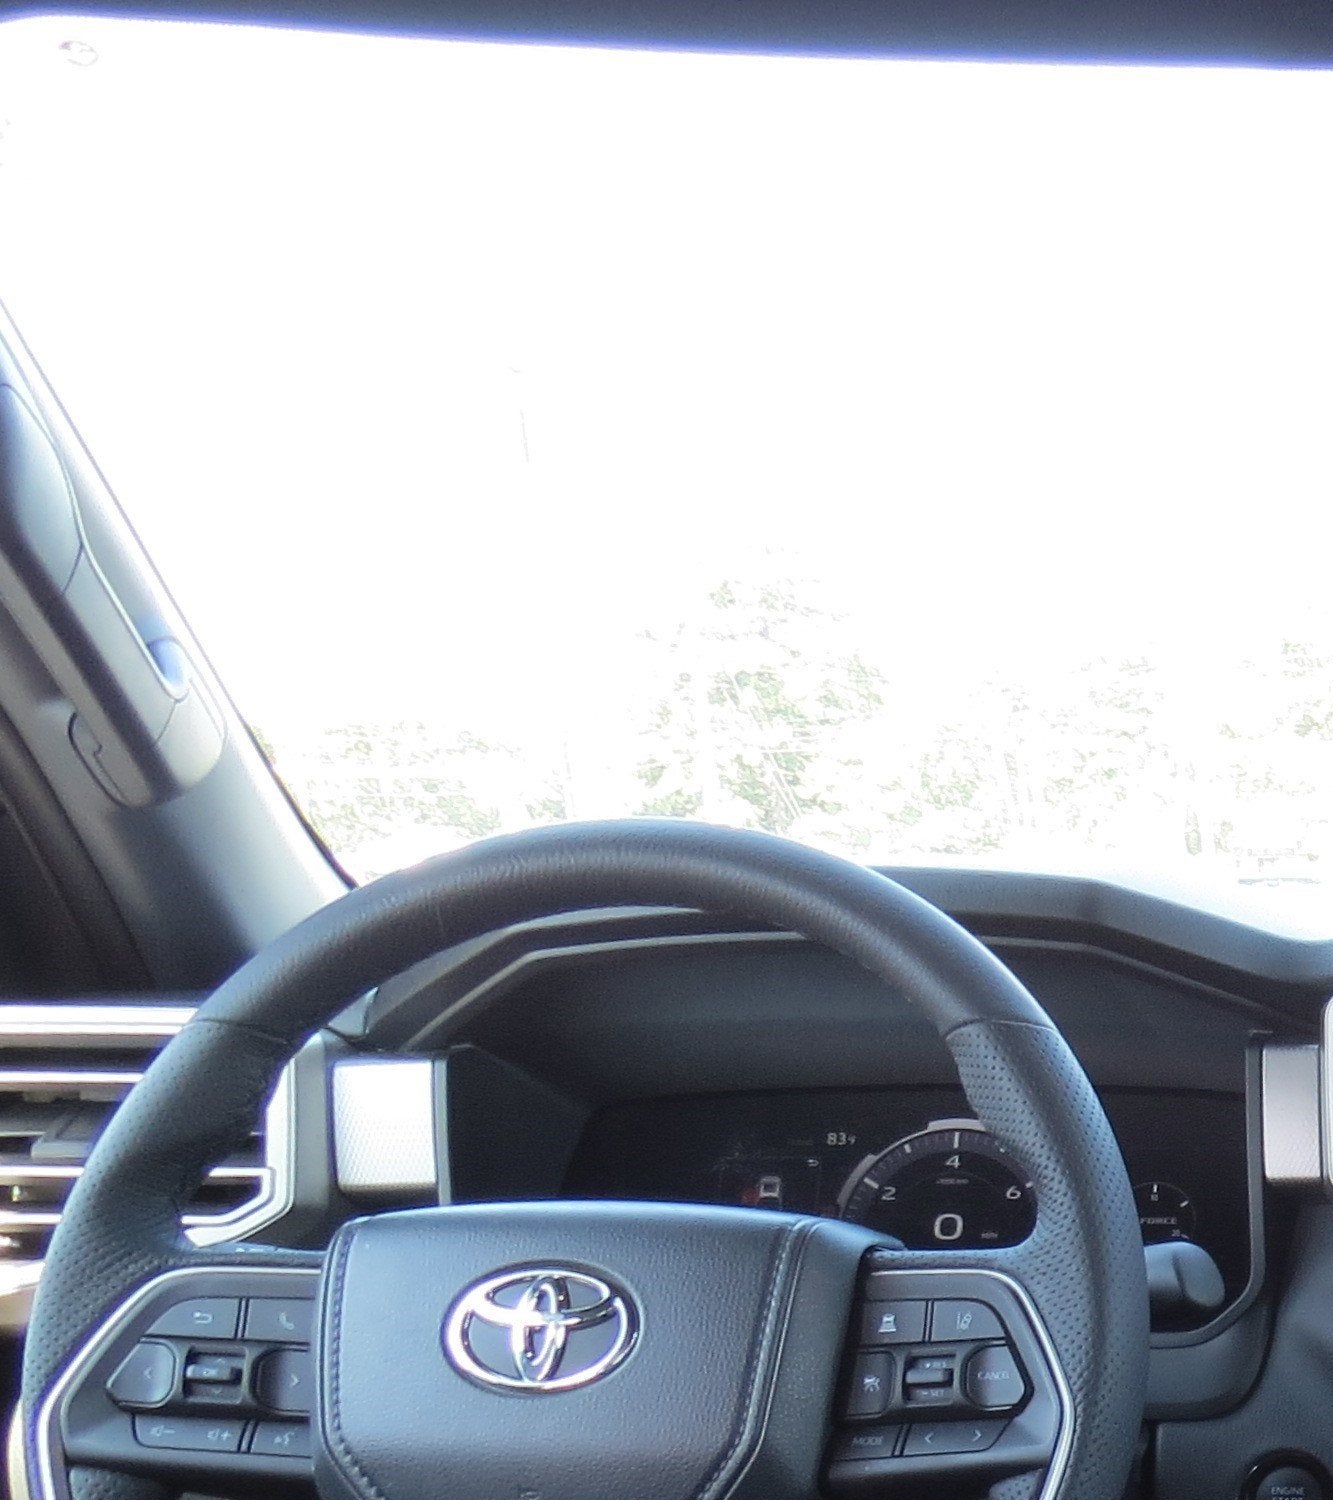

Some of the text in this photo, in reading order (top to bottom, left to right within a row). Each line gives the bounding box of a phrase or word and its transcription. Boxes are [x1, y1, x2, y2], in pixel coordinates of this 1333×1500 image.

[945, 1155, 961, 1169] 4
[882, 1186, 896, 1201] 2
[1005, 1185, 1022, 1200] 6
[934, 1213, 964, 1241] 0
[1271, 1486, 1305, 1496] ENGINE
